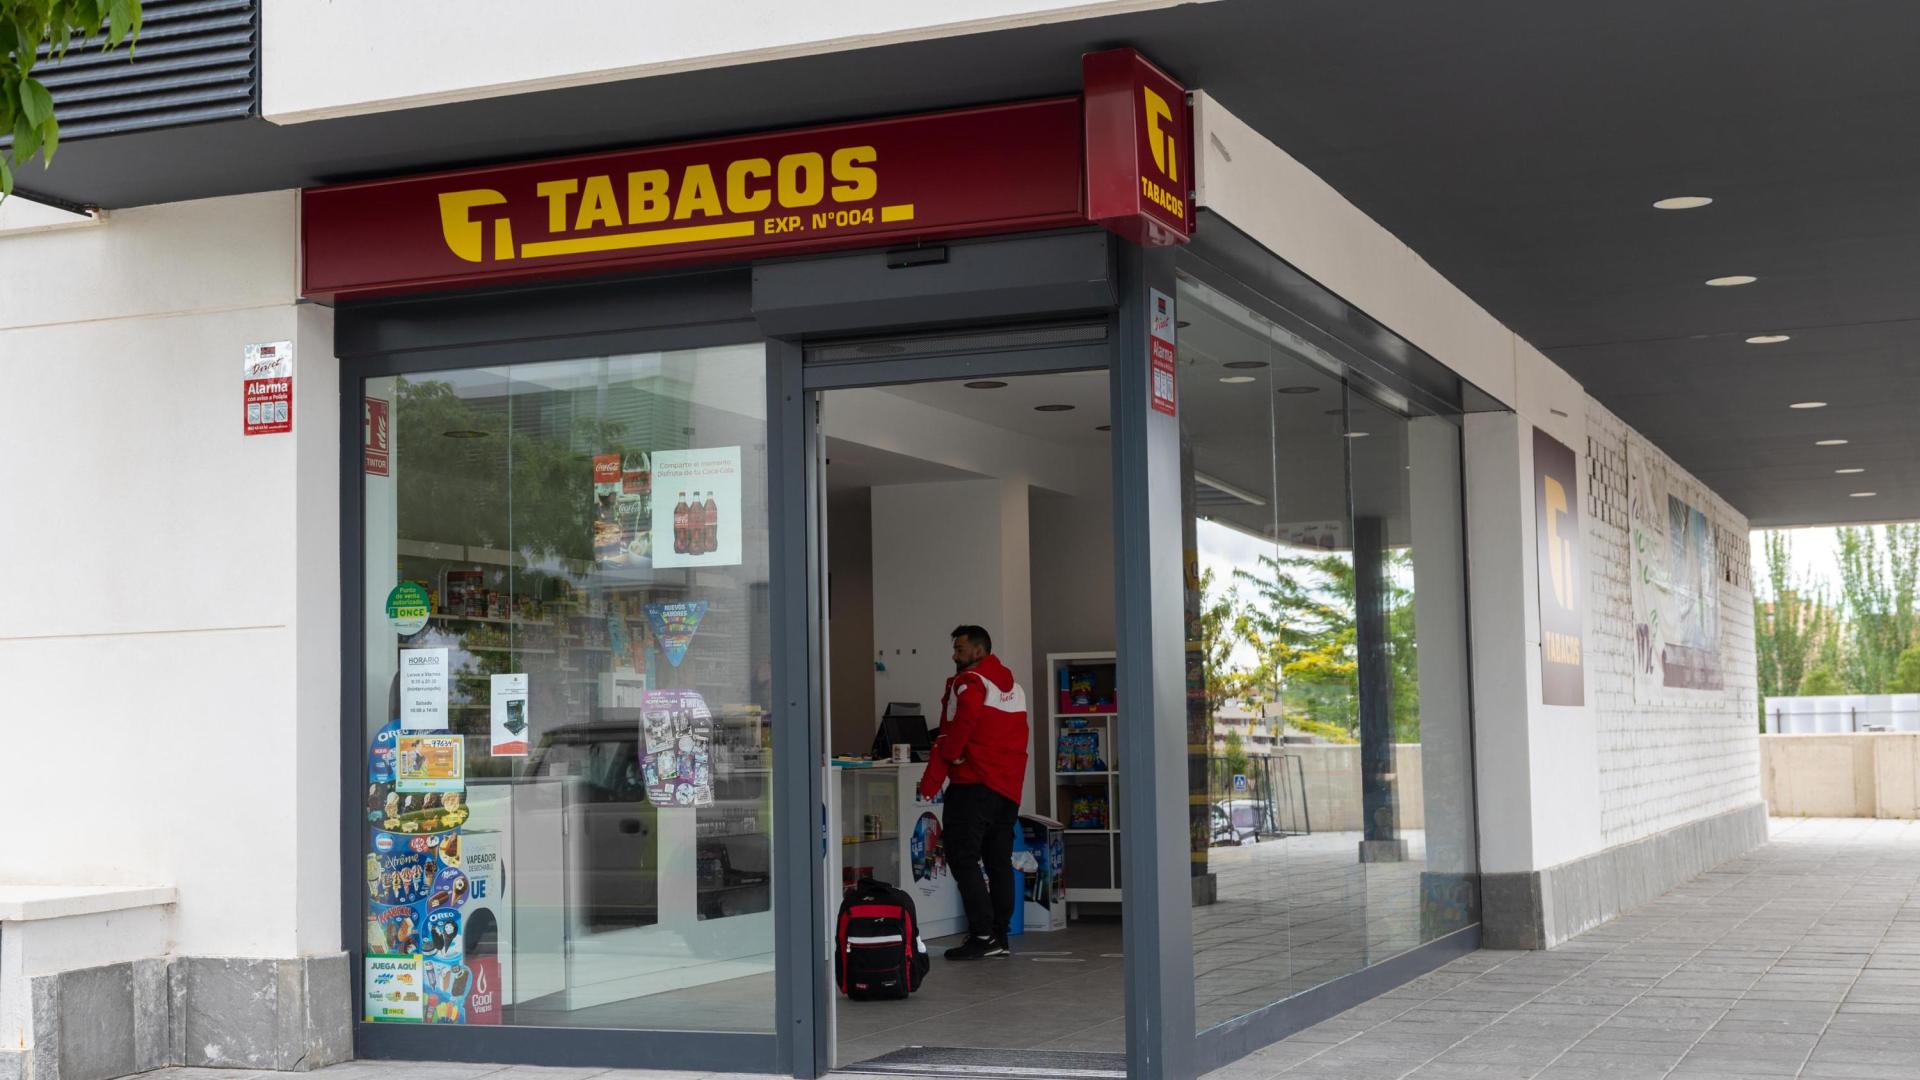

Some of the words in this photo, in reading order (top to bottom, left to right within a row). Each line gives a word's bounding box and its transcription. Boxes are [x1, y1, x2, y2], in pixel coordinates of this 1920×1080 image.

[537, 145, 878, 234] TABACOS
[1141, 175, 1184, 219] TABACOS
[764, 215, 805, 235] EXP.
[247, 382, 289, 395] Alarma
[399, 608, 425, 617] ONCE
[1544, 630, 1581, 666] TABACOS
[408, 657, 440, 665] HORARIO
[466, 853, 497, 864] VAPEADOR
[429, 912, 454, 922] OREO
[472, 992, 492, 1007] Cool
